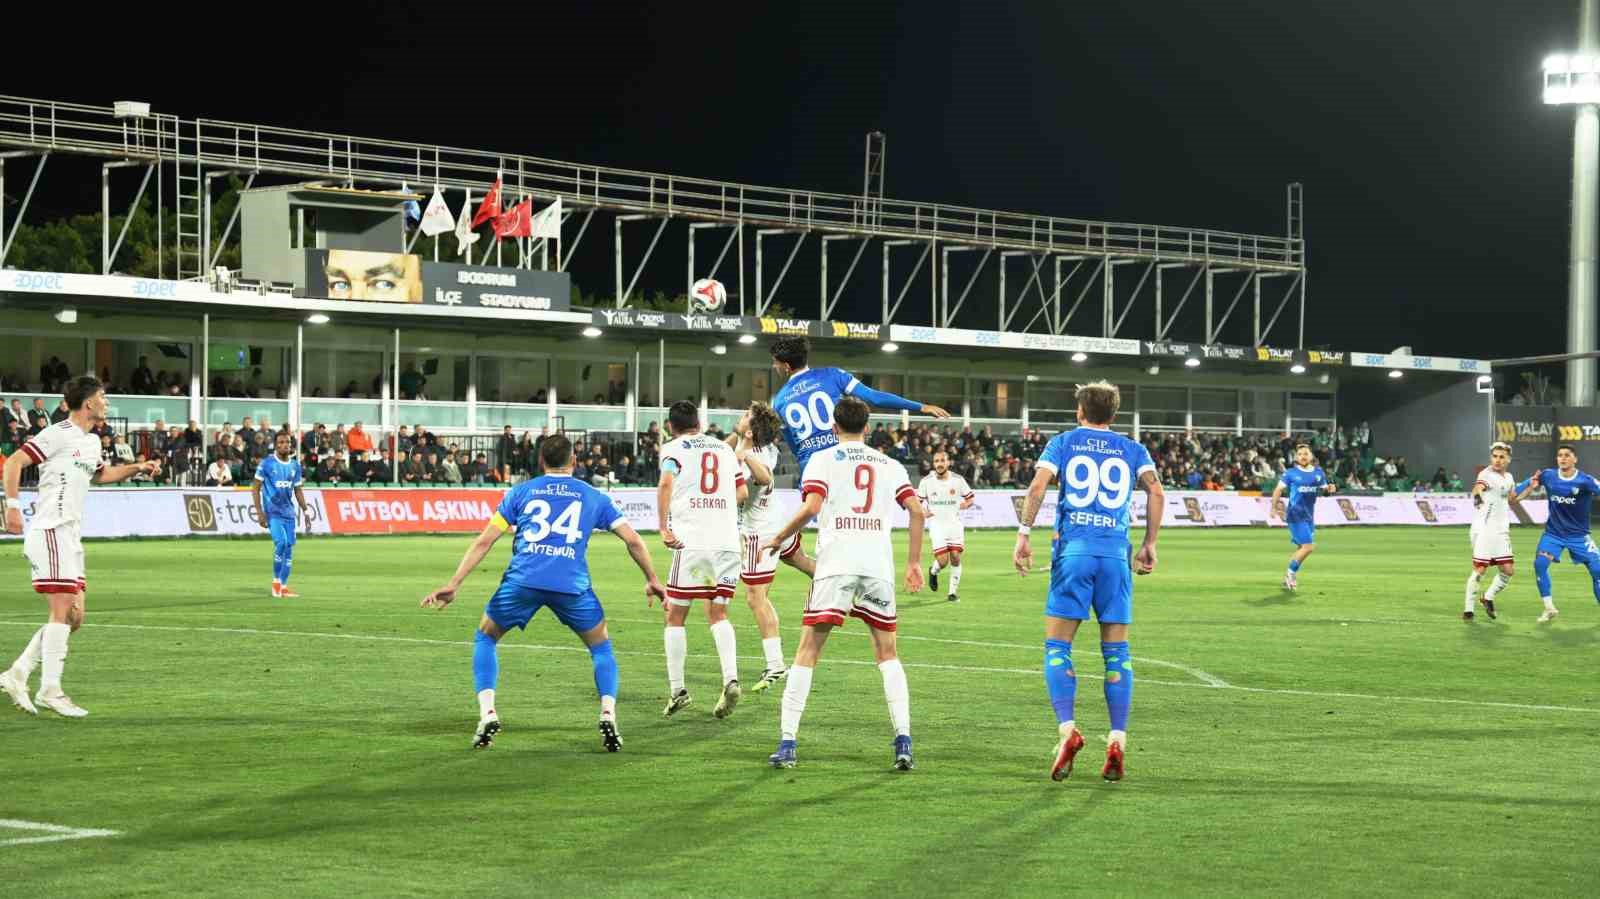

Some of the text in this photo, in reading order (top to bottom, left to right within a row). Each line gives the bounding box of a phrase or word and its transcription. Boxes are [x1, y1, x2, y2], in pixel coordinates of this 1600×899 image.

[458, 271, 516, 287] BODRUM
[435, 287, 463, 306] İLÇE
[776, 319, 810, 329] TALAY
[847, 323, 880, 333] TALAY
[1268, 348, 1293, 357] TALAY
[1319, 352, 1344, 360] TALAY
[785, 391, 835, 441] 90
[1515, 422, 1554, 435] TALAY
[700, 451, 719, 495] 8
[851, 463, 876, 514] 9
[1065, 455, 1131, 509] 99
[337, 500, 493, 523] FUTBOL AŞKINA
[690, 497, 727, 509] SERKAN
[522, 499, 583, 544] 34
[1069, 512, 1117, 528] SEFERI
[526, 542, 577, 560] AYTEMUR
